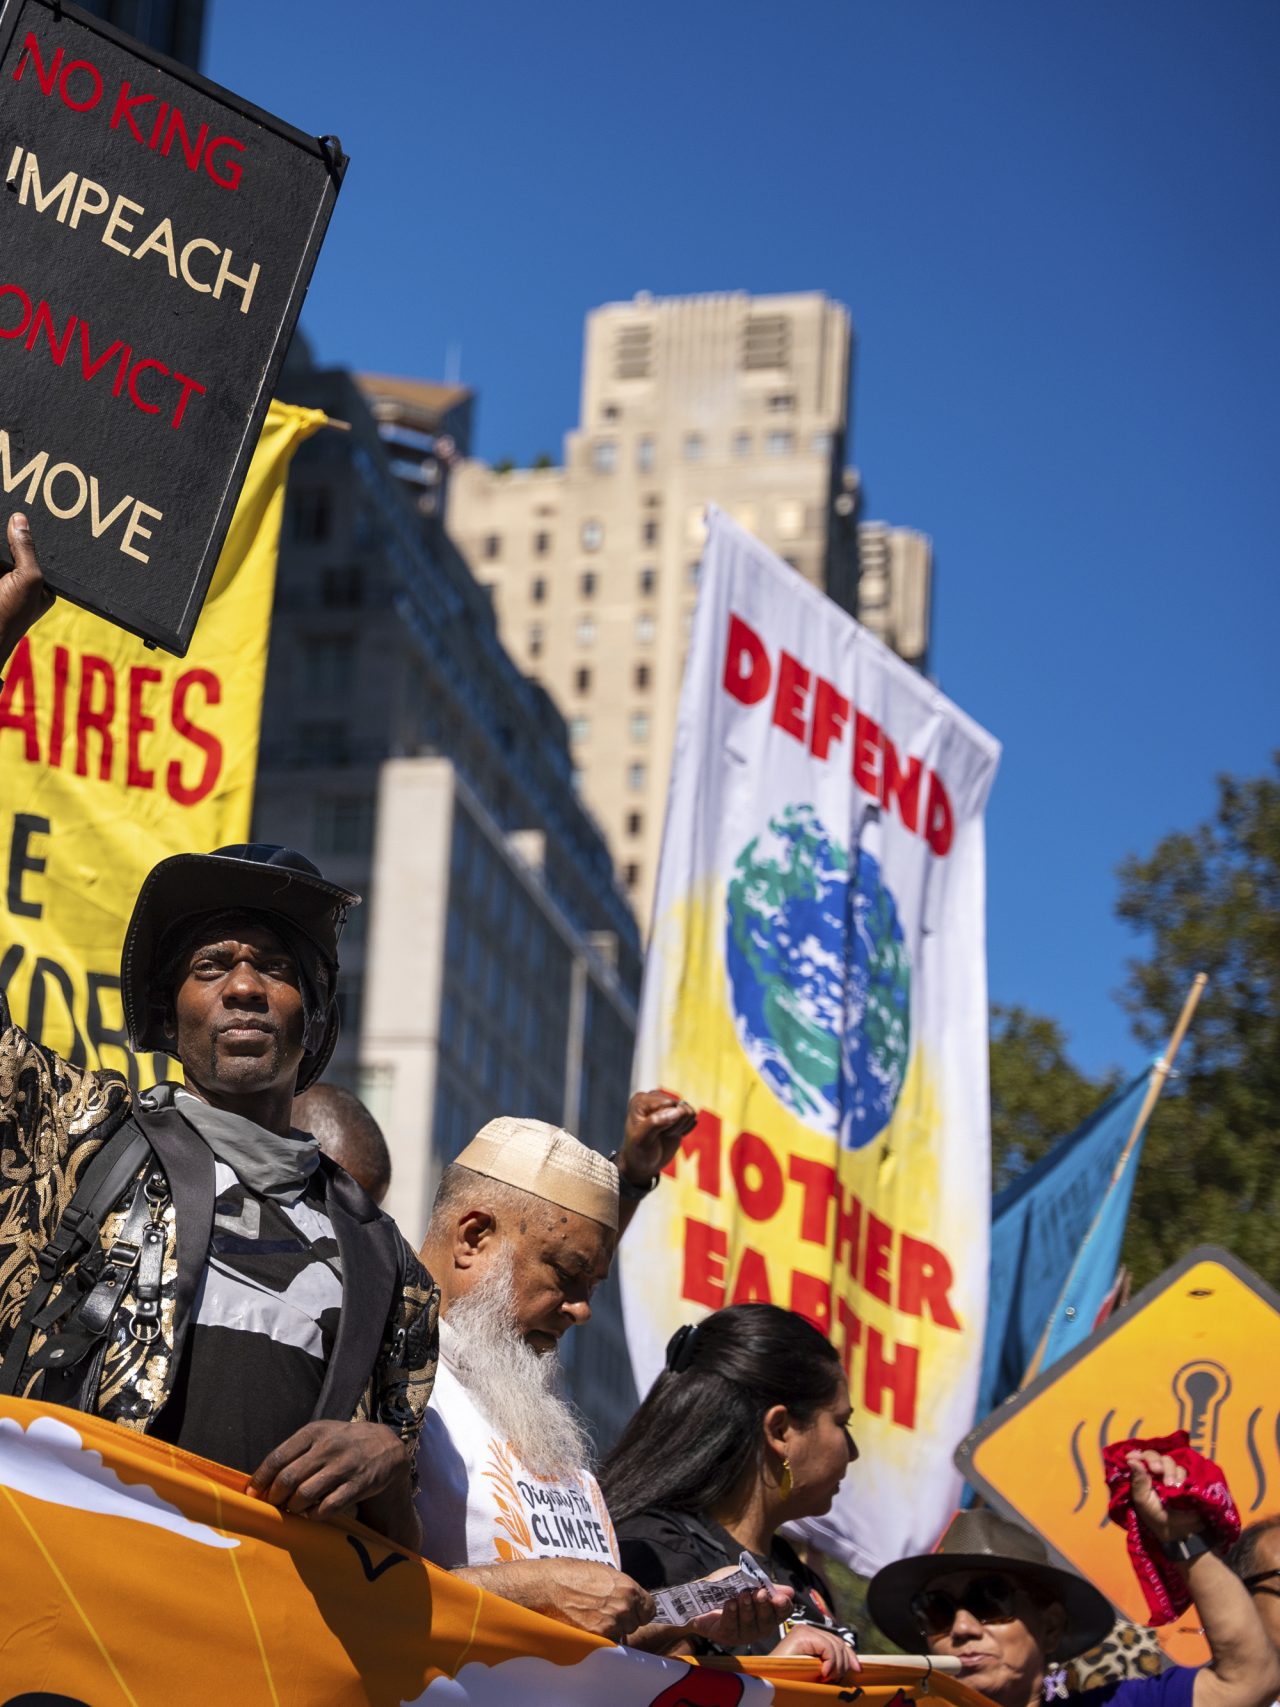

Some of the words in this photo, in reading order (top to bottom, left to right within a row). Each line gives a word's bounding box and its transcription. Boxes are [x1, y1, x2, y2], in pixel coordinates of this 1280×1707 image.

[13, 32, 104, 113] NO
[110, 81, 247, 191] KING
[5, 146, 261, 314] IMPEACH
[722, 610, 955, 858] DEFEND
[658, 1088, 962, 1332] MOTHER
[531, 1513, 609, 1554] CLIMATE
